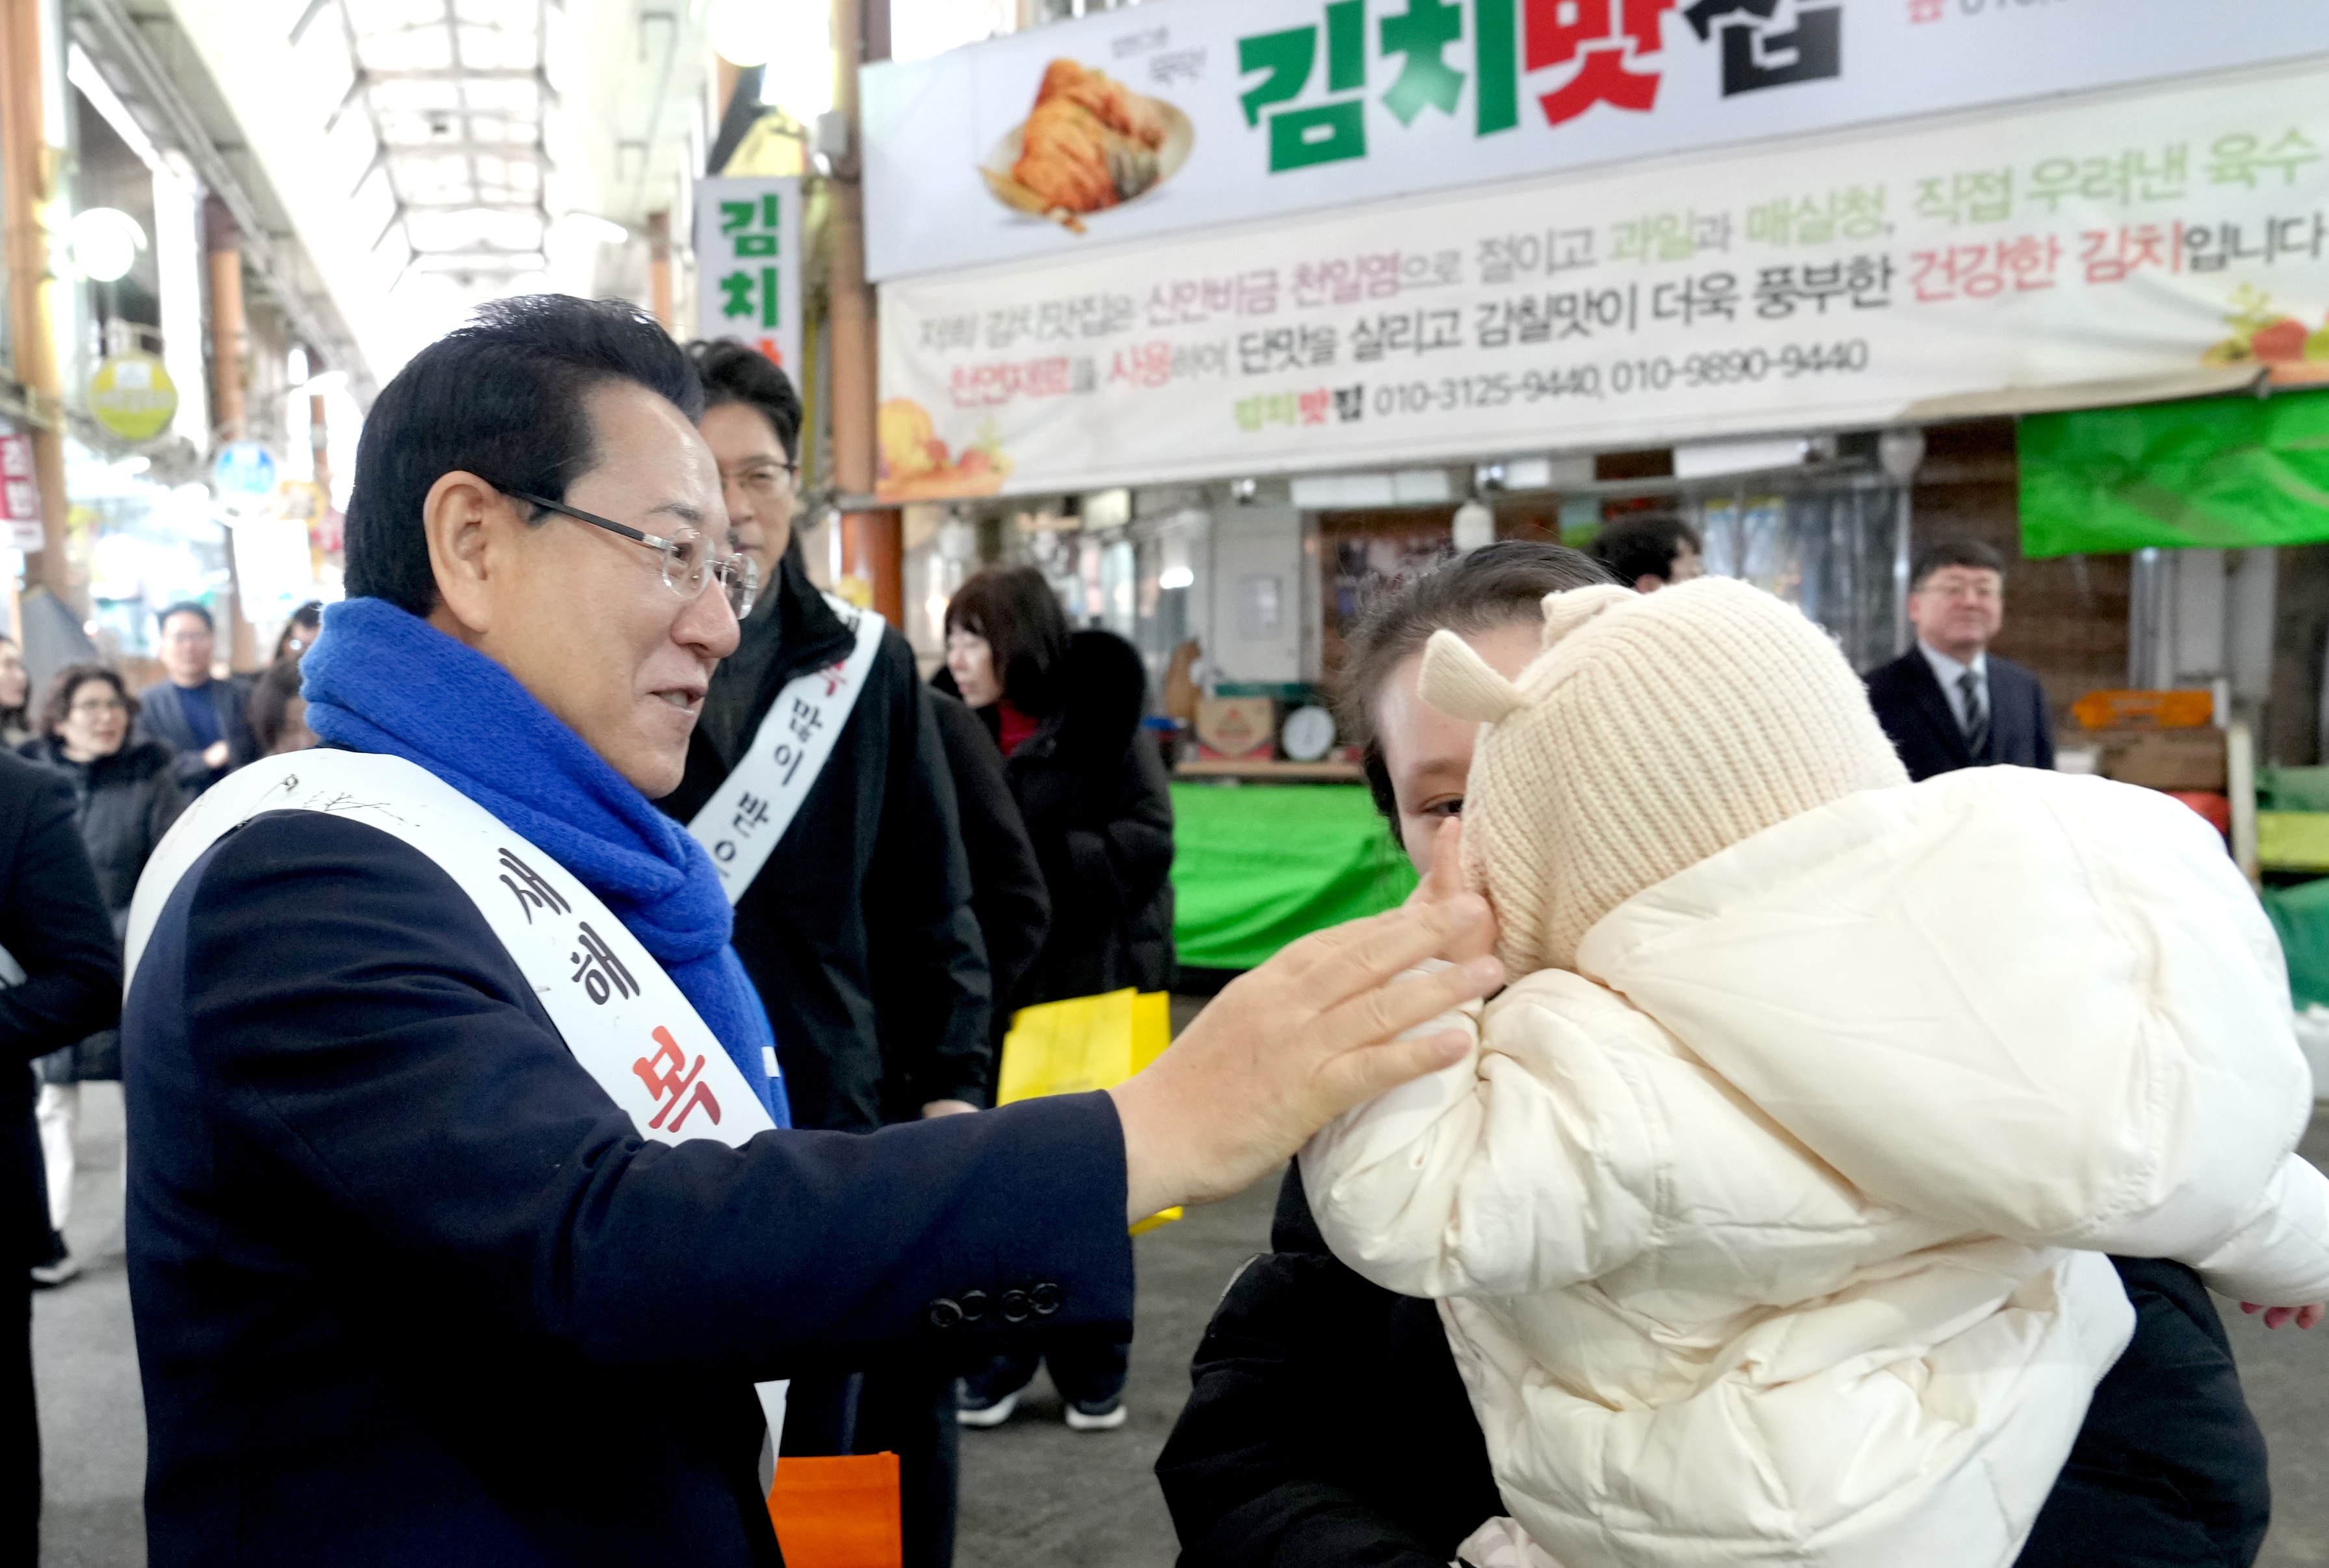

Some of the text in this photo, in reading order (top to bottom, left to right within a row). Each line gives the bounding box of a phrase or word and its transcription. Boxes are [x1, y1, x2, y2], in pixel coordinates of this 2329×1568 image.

[719, 194, 783, 367] 김치
[1237, 323, 1336, 377] 단맛을
[1349, 309, 1464, 364] 살리고
[1475, 282, 1638, 350] 감칠맛이
[1651, 270, 1741, 325] 더욱
[1750, 255, 1895, 320] 풍부한
[1909, 233, 2062, 304] 건강한
[2079, 210, 2329, 285] 김치입니다
[1291, 249, 1463, 309] 천일염으로
[1476, 228, 1598, 286] 절이고
[1609, 210, 1732, 265] 과일과
[1912, 166, 2013, 226] 직접
[2025, 140, 2189, 213] 우려낸
[2203, 126, 2322, 190] 육수
[1611, 338, 1871, 394] 010-9890-9440
[498, 847, 721, 1133] 새해 복
